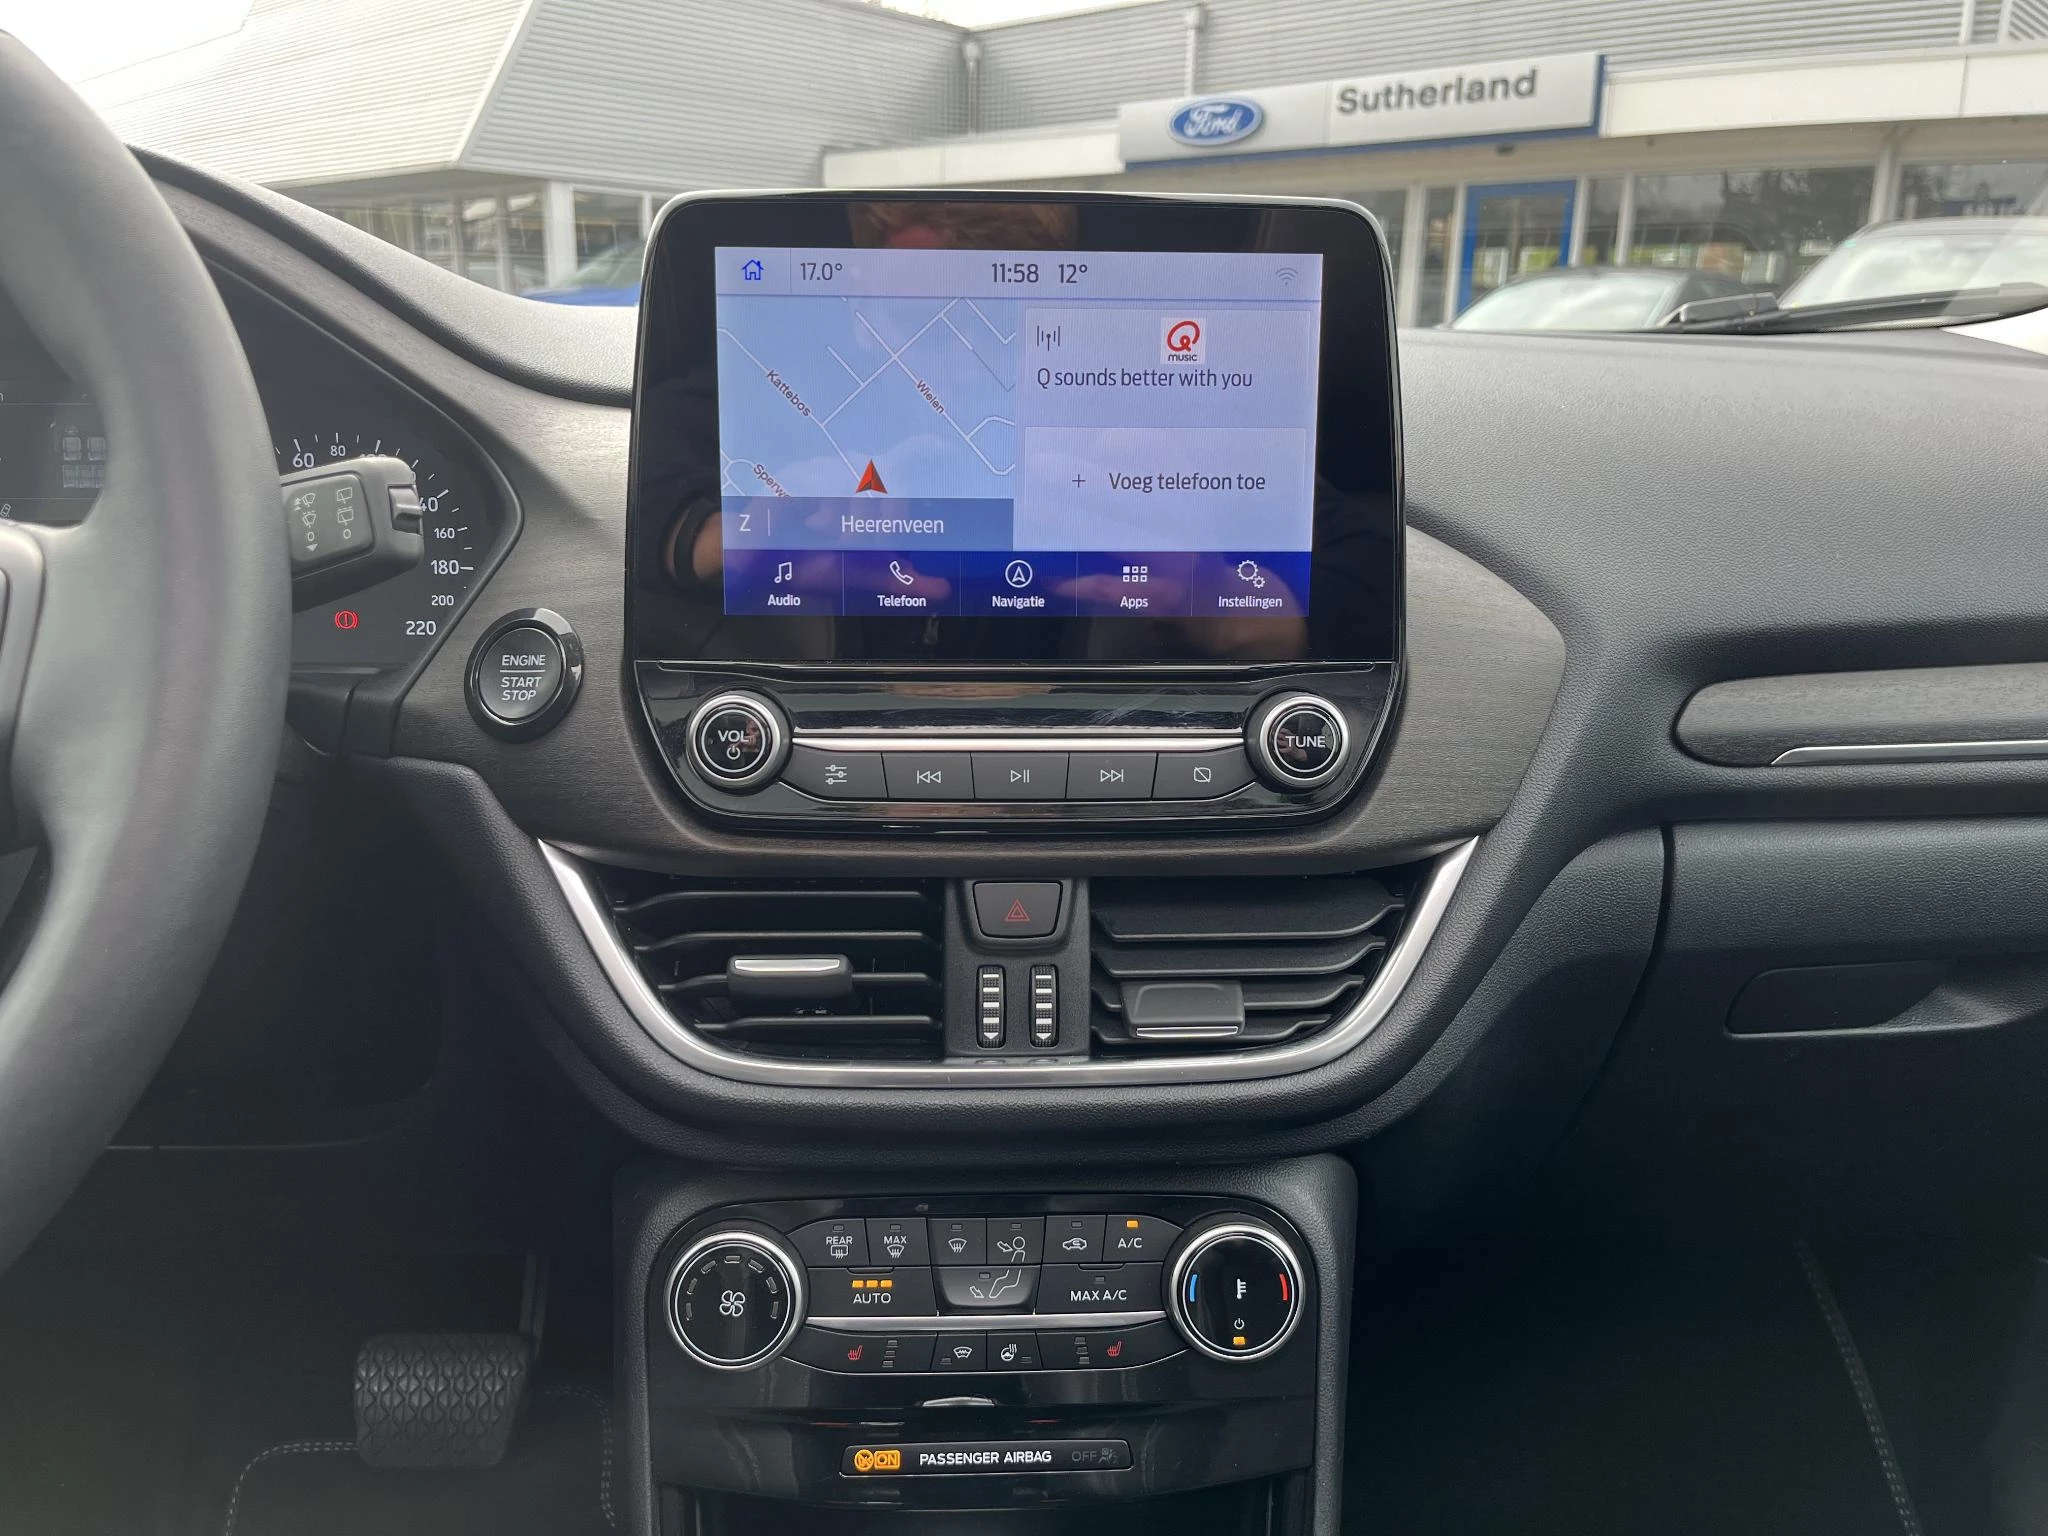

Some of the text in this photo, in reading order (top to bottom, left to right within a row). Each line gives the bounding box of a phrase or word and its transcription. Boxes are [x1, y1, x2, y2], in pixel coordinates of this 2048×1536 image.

[1336, 65, 1538, 115] Sutherland
[799, 262, 843, 281] 17.0°
[991, 262, 1088, 284] 11:58 12°
[1037, 368, 1253, 390] Q sounds better with you
[766, 370, 811, 417] Kattebos
[916, 379, 945, 414] Wielen
[330, 445, 346, 457] 80
[292, 452, 315, 468] 60
[1109, 472, 1266, 493] Voeg telefoon toe
[419, 496, 438, 512] 40
[738, 514, 944, 533] Z Heerenveen
[433, 527, 455, 539] 160
[430, 559, 460, 575] 180
[431, 594, 455, 606] 200
[767, 594, 801, 607] Audio
[877, 595, 926, 607] Telefoon
[992, 595, 1045, 609] Navigatie
[1120, 595, 1149, 609] Apps
[1218, 595, 1282, 609] Instellingen
[405, 620, 437, 636] 220
[501, 654, 546, 667] ENGINE
[501, 676, 542, 688] START
[502, 689, 537, 701] STOP
[717, 729, 750, 743] VOL
[1284, 735, 1326, 748] TUNE
[825, 1236, 853, 1246] REAR
[883, 1235, 908, 1245] MAX
[1117, 1237, 1143, 1249] A/C
[853, 1293, 892, 1304] AUTO
[1070, 1289, 1128, 1302] MAX A/C
[877, 1453, 898, 1466] ON
[919, 1450, 1052, 1466] PASSENGER AIRBAG
[1071, 1450, 1097, 1462] OFF
